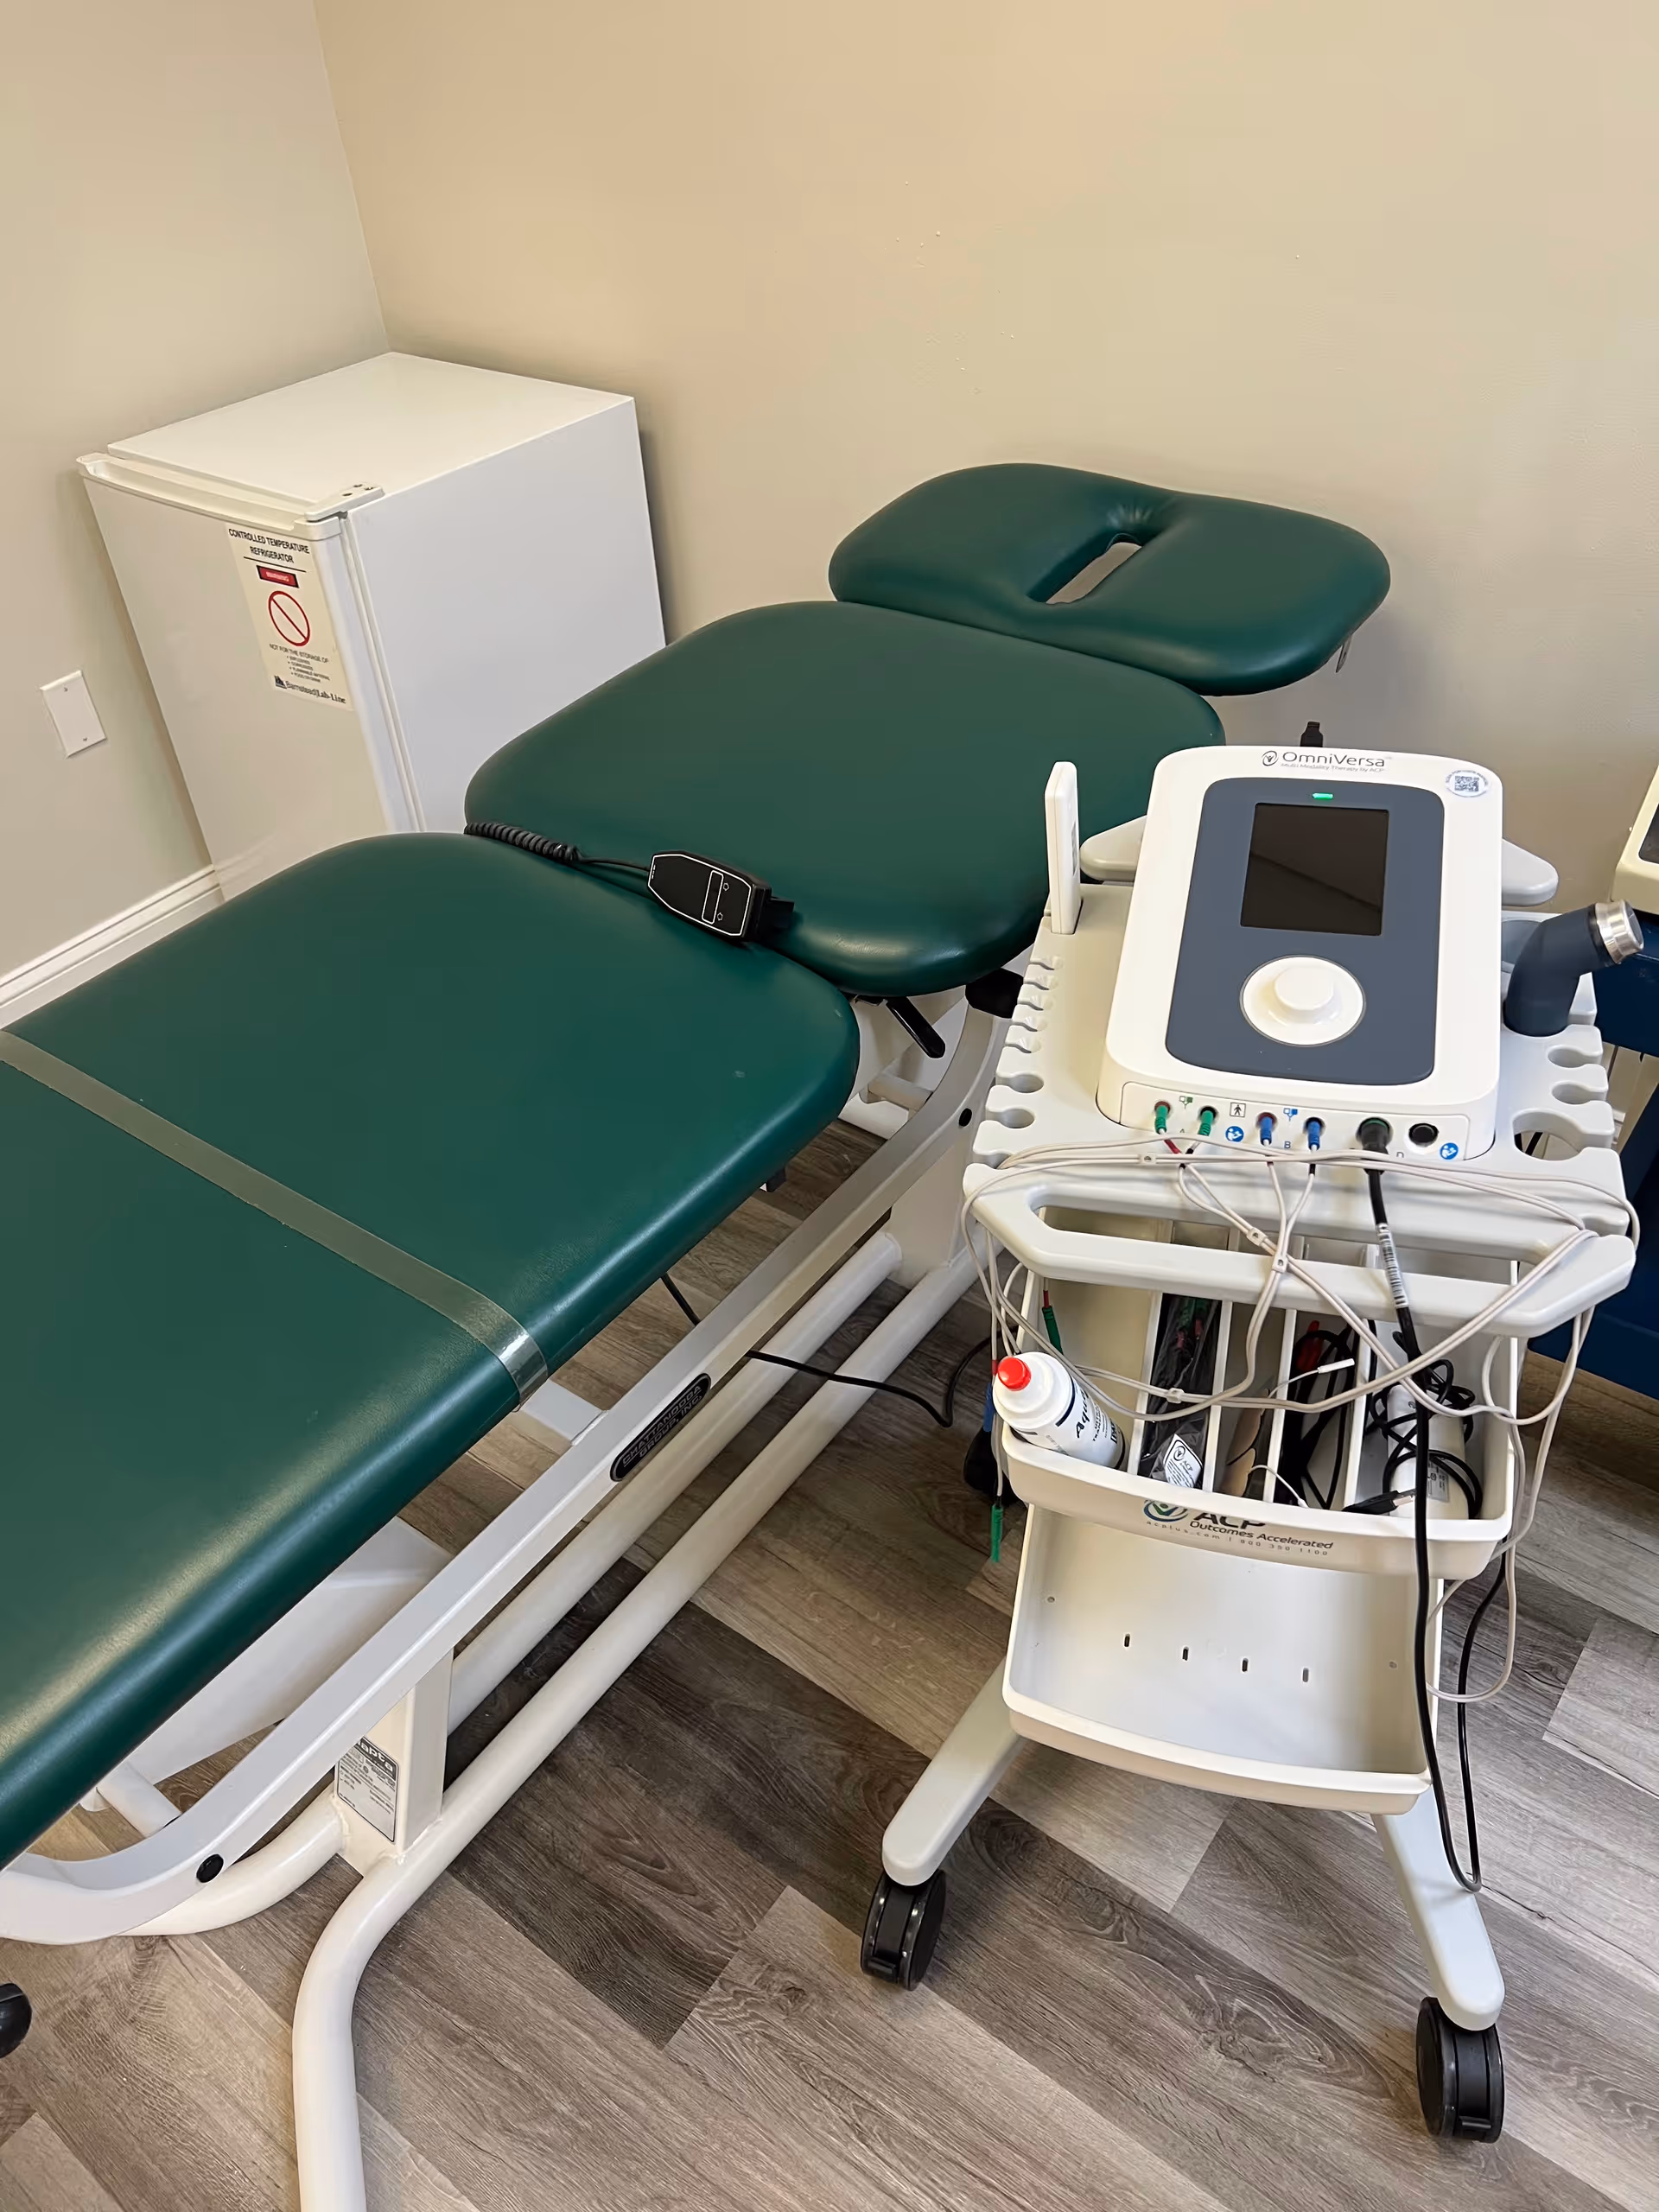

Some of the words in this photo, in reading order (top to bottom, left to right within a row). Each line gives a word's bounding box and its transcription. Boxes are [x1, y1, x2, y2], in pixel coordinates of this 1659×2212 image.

[228, 528, 266, 544] CONTROLLED
[265, 537, 310, 554] TEMPERATURE
[249, 545, 295, 563] REFRIGERATOR
[1282, 751, 1385, 767] OmniVersa
[622, 1385, 702, 1465] CHATTANOOGA
[1189, 1520, 1254, 1539] Outcomes
[1256, 1533, 1334, 1549] Accelerated
